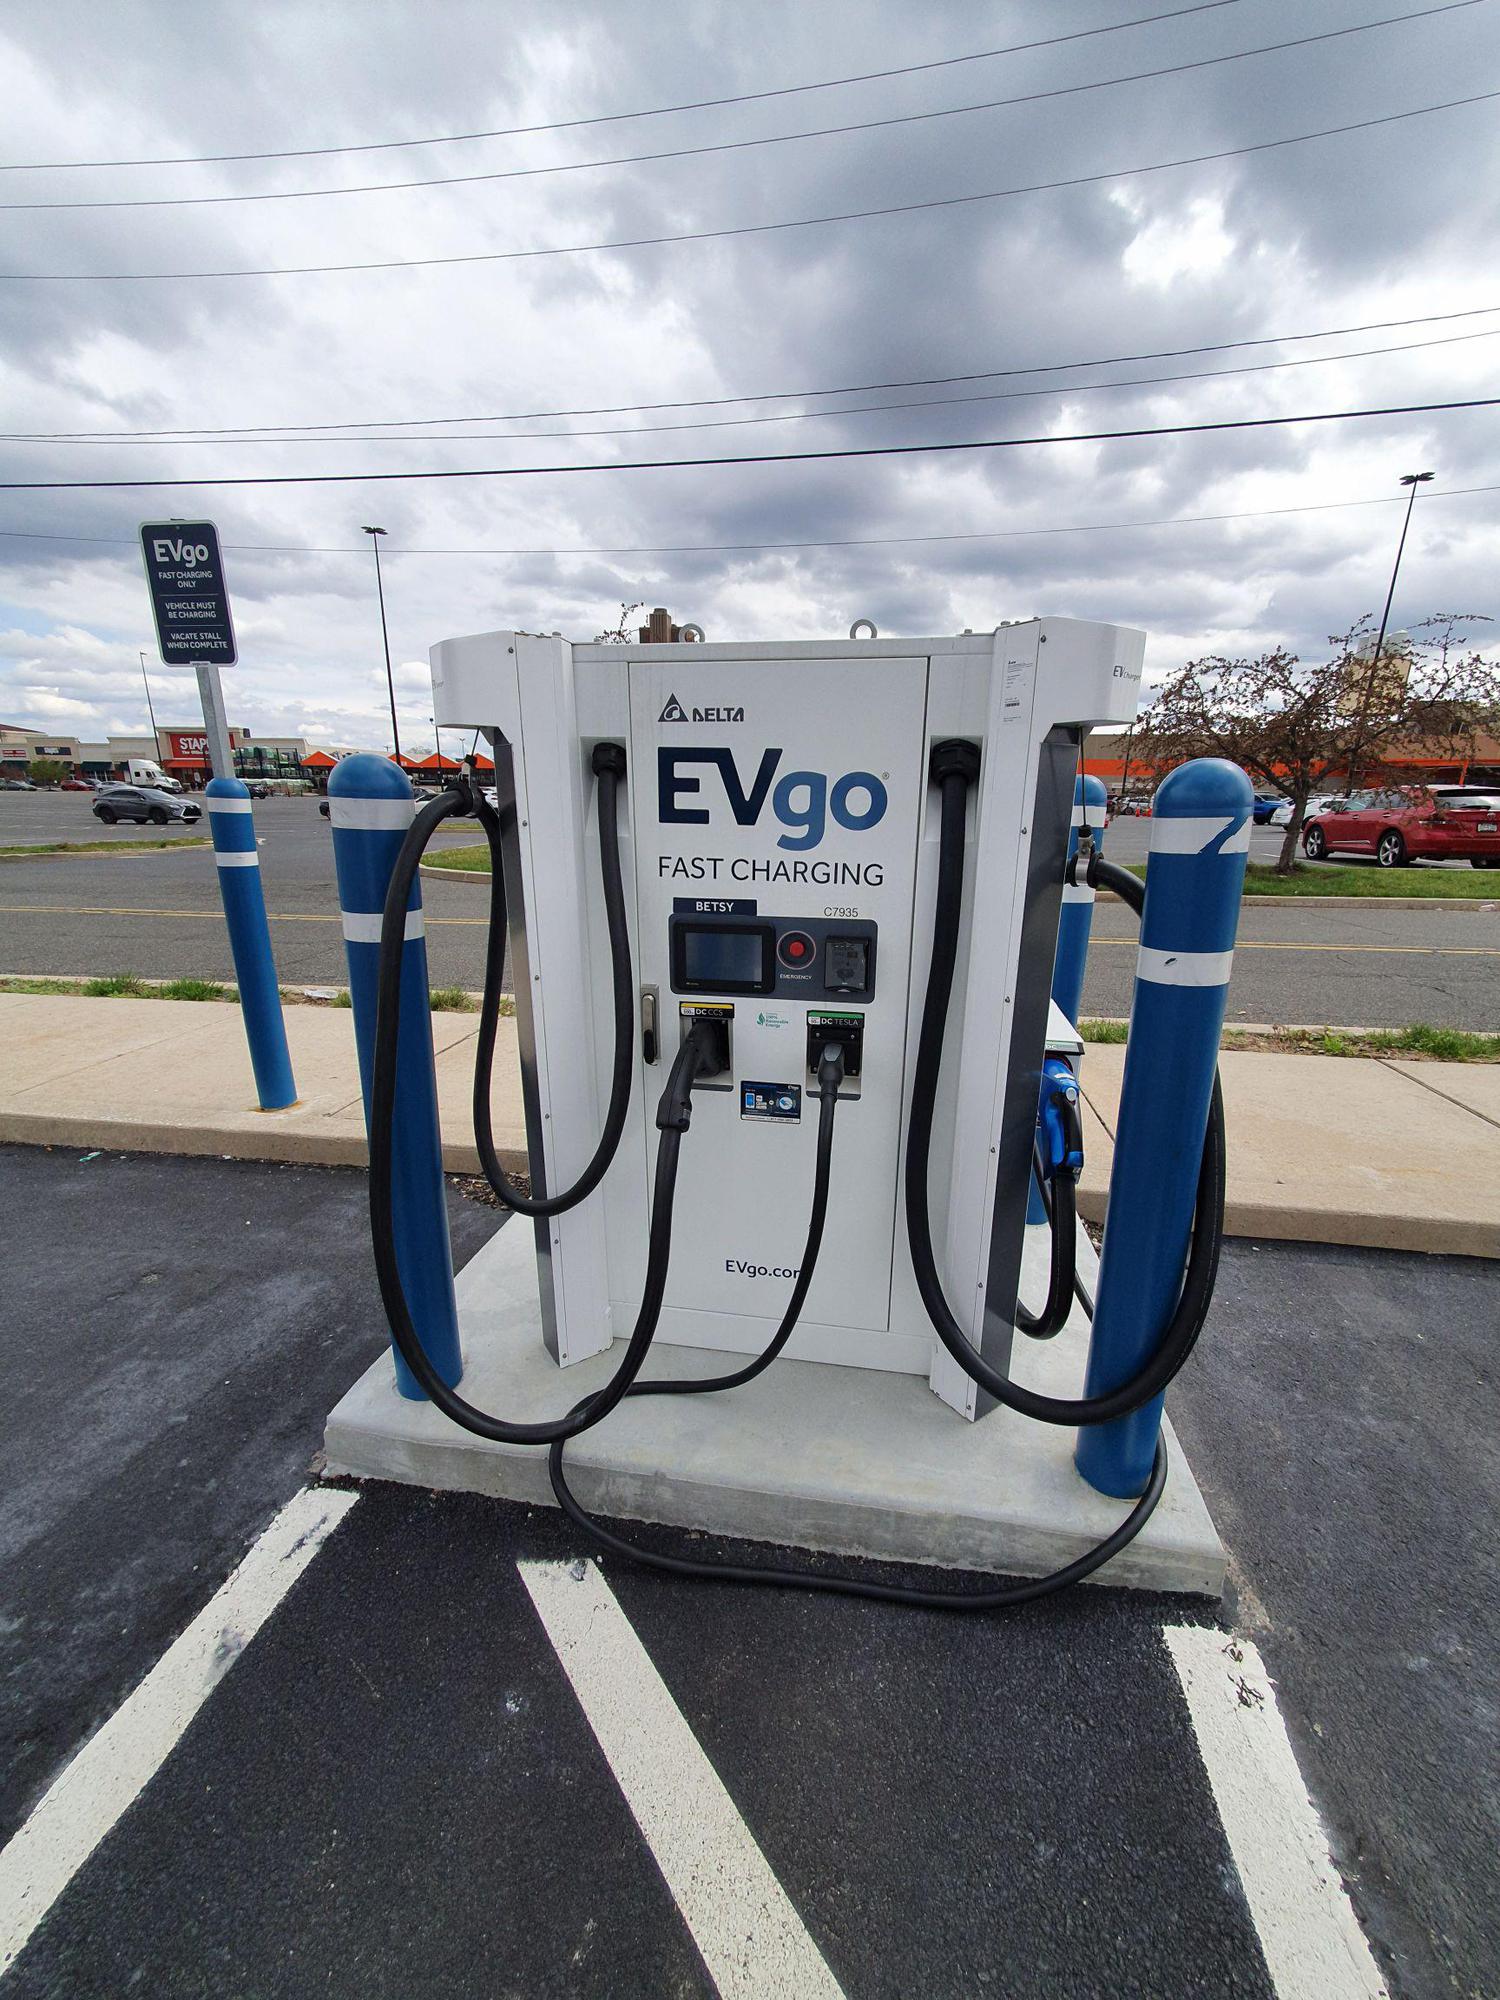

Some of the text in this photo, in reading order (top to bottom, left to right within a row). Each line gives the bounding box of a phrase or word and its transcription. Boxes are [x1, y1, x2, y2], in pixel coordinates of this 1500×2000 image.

[153, 539, 209, 568] EVgo
[176, 571, 213, 579] CHARGING
[165, 602, 196, 610] VEHICLE
[168, 611, 178, 619] BE
[167, 641, 228, 649] WHEN COMPLETE
[693, 707, 744, 722] DELTA
[179, 737, 209, 751] STAP
[658, 746, 888, 851] EVgo
[658, 856, 884, 887] FAST CHARGING
[695, 901, 735, 912] BETSY
[823, 906, 859, 918] C7935
[707, 1009, 724, 1017] CCS
[821, 1017, 833, 1025] DC
[834, 1018, 859, 1026] TESLA
